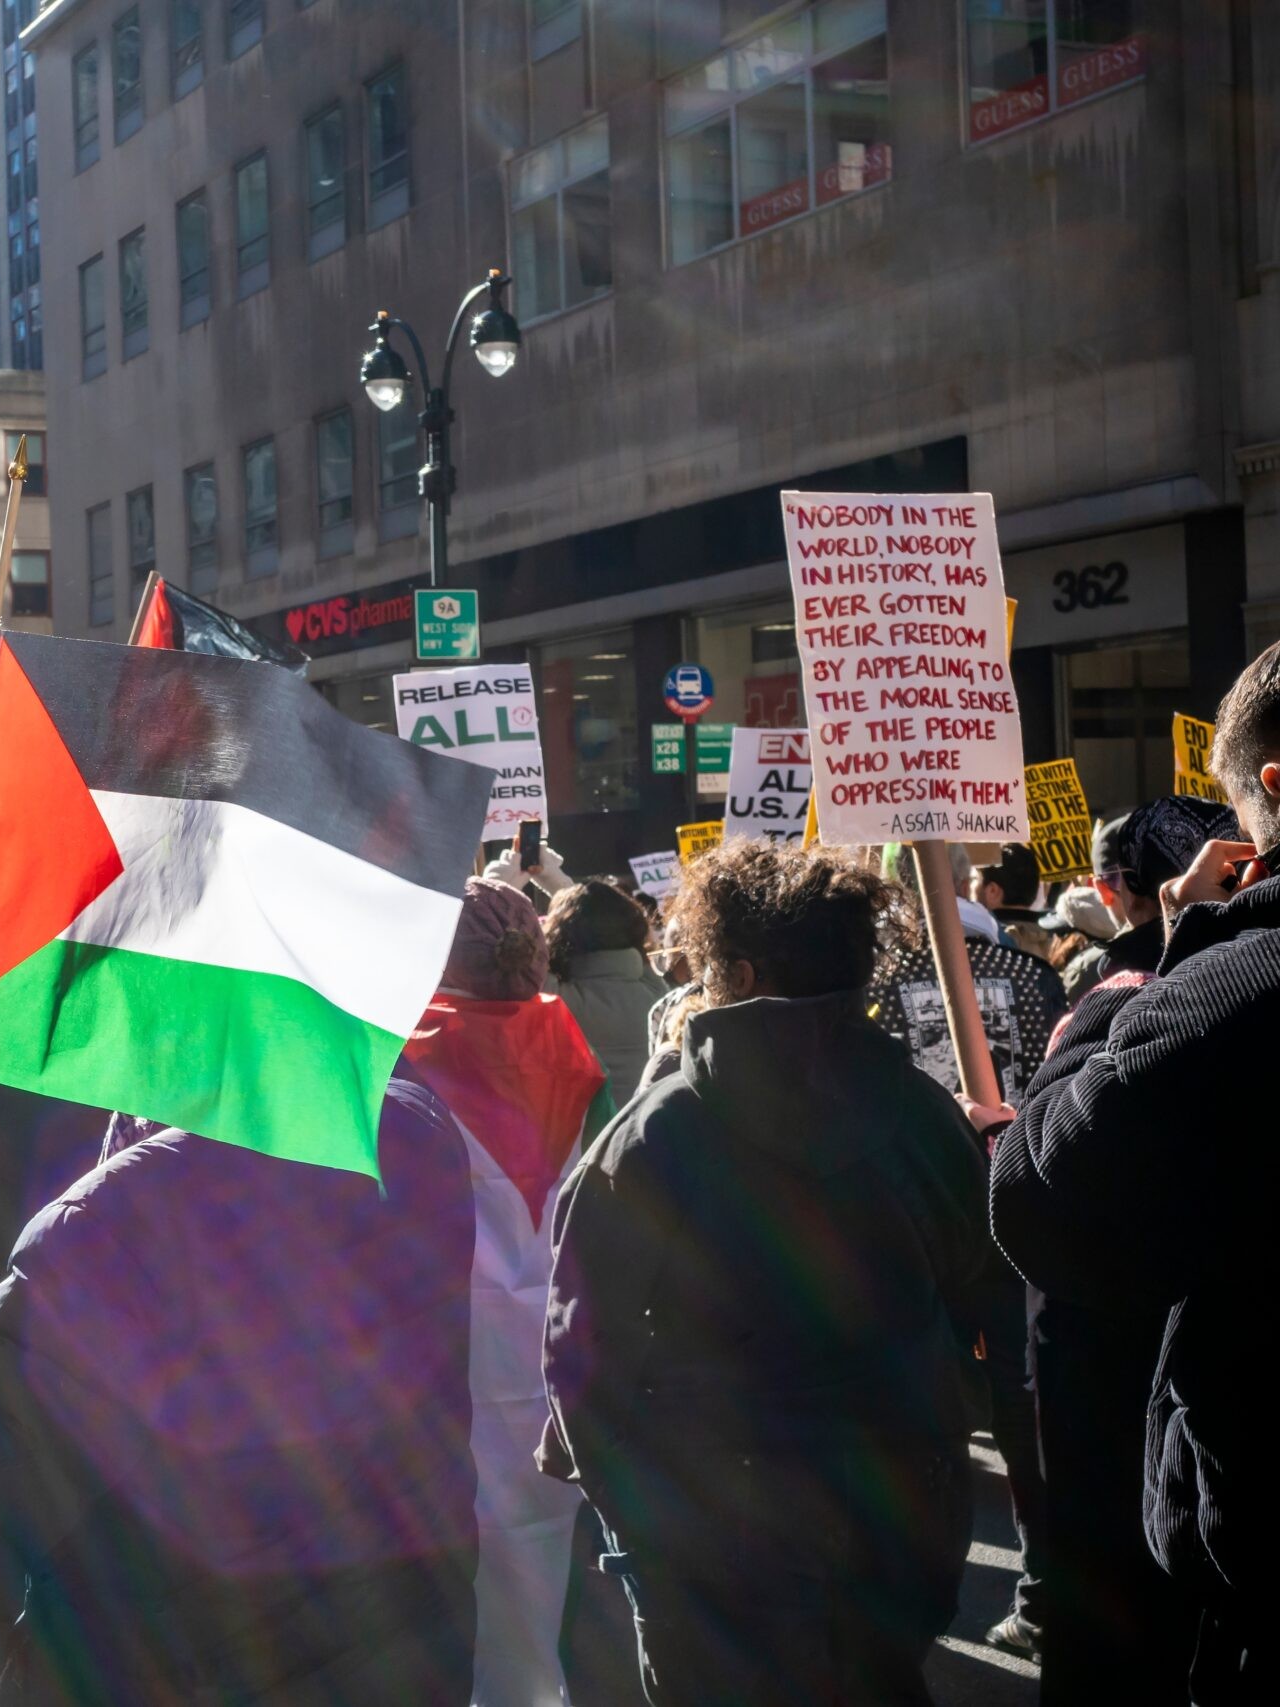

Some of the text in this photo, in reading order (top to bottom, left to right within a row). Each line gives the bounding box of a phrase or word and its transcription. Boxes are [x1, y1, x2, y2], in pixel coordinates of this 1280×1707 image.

[1063, 40, 1139, 89] GUESS
[975, 85, 1045, 132] GUESS
[823, 151, 883, 190] GSS
[747, 188, 803, 225] GUESS
[901, 505, 927, 526] IN
[932, 507, 977, 528] THE
[797, 535, 976, 560] WORLD, NOBODY
[801, 563, 987, 588] IN HISTORY, HAS
[1052, 561, 1130, 614] 362
[305, 595, 413, 641] CVS pharma
[438, 601, 456, 614] 9A
[804, 592, 966, 621] EVER GOTTEN
[423, 623, 446, 633] WEST
[804, 622, 987, 649] THEIR FREEDOM
[813, 655, 1004, 685] BY APPEALING TO
[399, 677, 532, 706] RELEASE
[816, 686, 1015, 714] THE MORAL SENSE
[409, 706, 536, 749] ALL
[820, 717, 997, 746] OF THE PEOPLE
[1183, 719, 1208, 750] END
[760, 735, 812, 762] EN
[1189, 746, 1208, 777] AL
[826, 750, 961, 776] WHO WERE
[1040, 762, 1073, 780] WITH
[758, 769, 813, 793] AL
[831, 778, 957, 806] OPPRESSING
[1027, 777, 1080, 801] ESTINE!
[730, 796, 789, 820] U.S.
[957, 811, 1020, 833] SHAKUR
[1028, 794, 1087, 823] ND THE
[1029, 818, 1090, 842] CCUPATION
